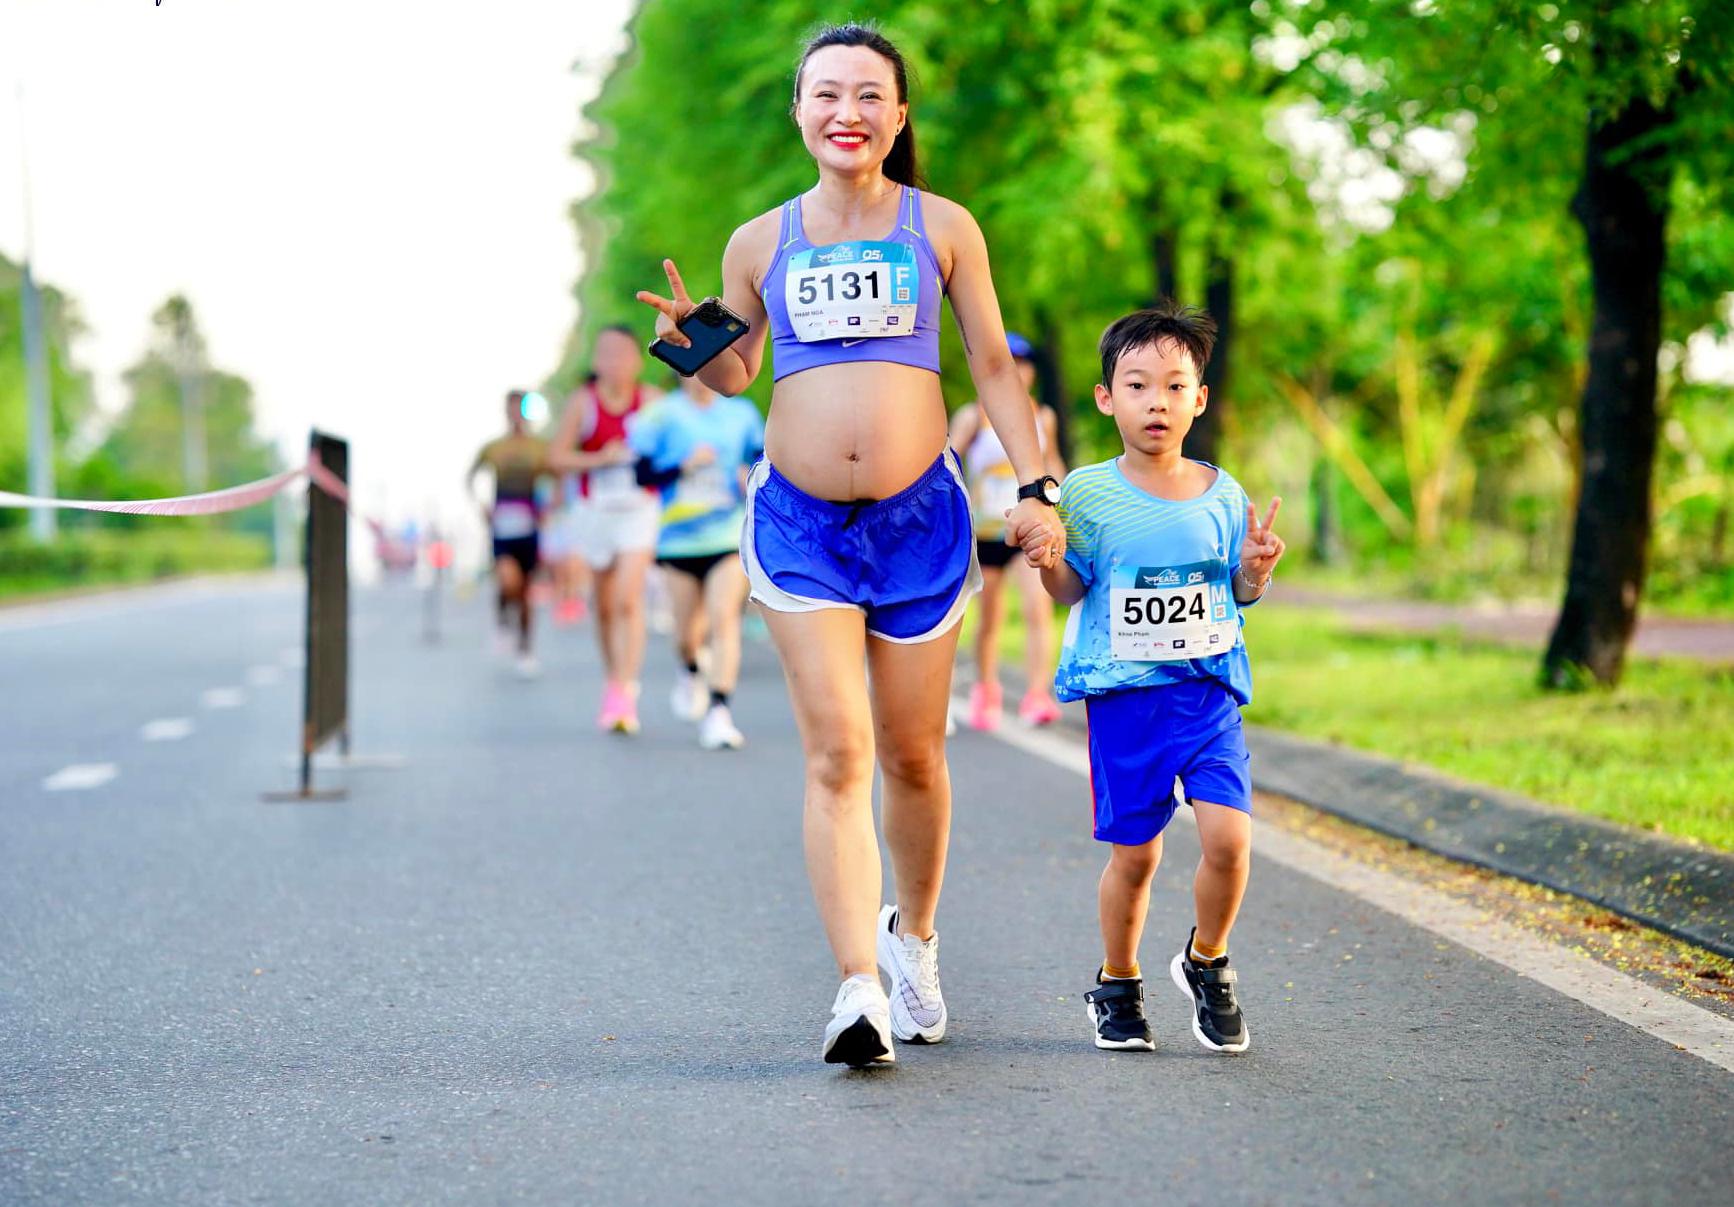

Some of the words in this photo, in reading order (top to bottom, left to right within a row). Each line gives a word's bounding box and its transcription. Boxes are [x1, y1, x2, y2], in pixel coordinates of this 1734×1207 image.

[896, 266, 910, 286] F
[798, 270, 879, 304] 5131
[1153, 574, 1180, 583] PEACE
[1211, 584, 1228, 604] M
[1123, 592, 1205, 625] 5024
